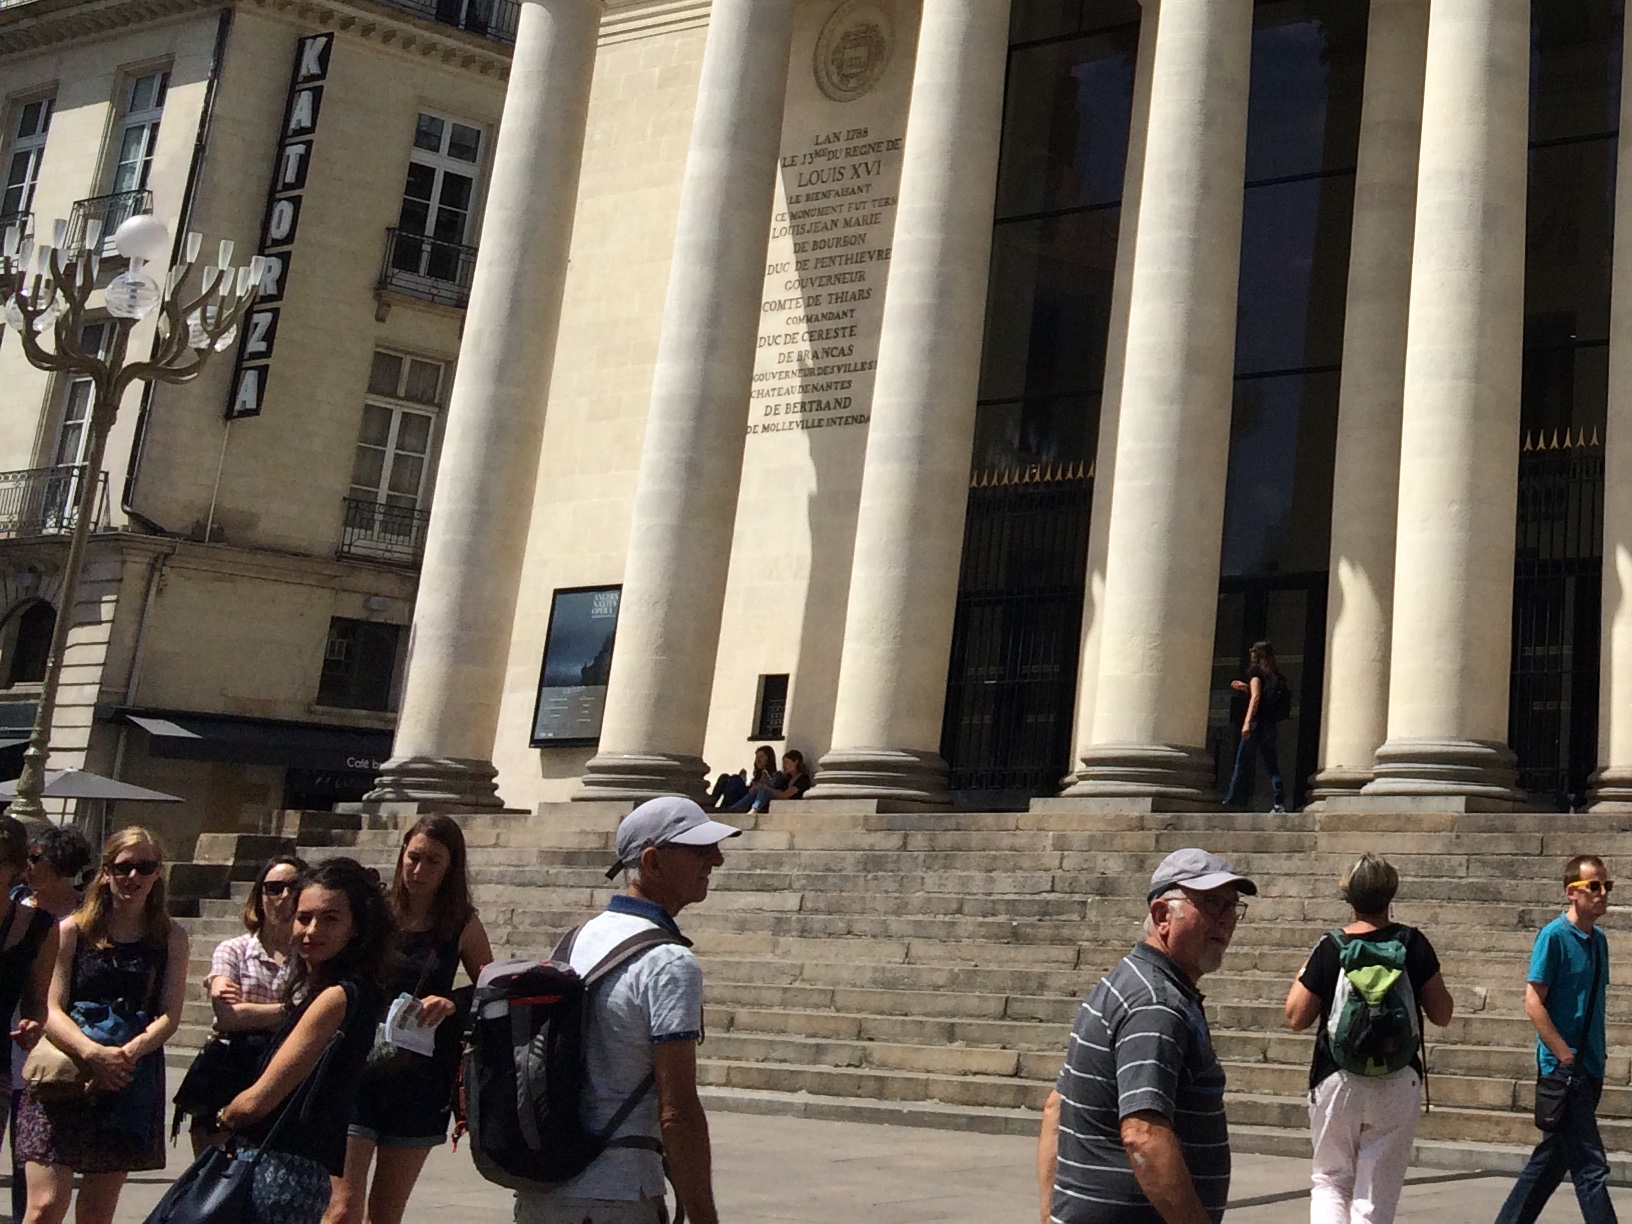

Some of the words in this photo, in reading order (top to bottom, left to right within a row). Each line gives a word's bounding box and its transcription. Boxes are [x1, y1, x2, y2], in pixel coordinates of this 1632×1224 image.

[781, 155, 799, 168] LE
[827, 148, 843, 162] DU
[844, 141, 885, 158] REGNE
[886, 138, 902, 152] DE
[797, 166, 846, 188] LOUIS
[849, 159, 882, 180] XVI
[788, 194, 802, 205] LE
[775, 212, 788, 222] CE
[790, 204, 844, 221] MONUMENT
[847, 200, 868, 212] FUT
[233, 36, 328, 412] KATORZA
[771, 223, 806, 239] LOUIS
[807, 218, 840, 234] JEAN
[842, 212, 882, 229] MARIE
[793, 241, 810, 254] DE
[812, 233, 867, 251] BOURBON
[767, 262, 790, 275] DUC
[794, 259, 810, 272] DE
[785, 270, 866, 291] GOUVERNEUR
[762, 297, 803, 313] COMTE
[806, 294, 822, 308] DE
[827, 288, 873, 305] THIARS
[786, 308, 856, 326] COMMANDANT
[758, 335, 782, 348] DUC
[783, 332, 799, 345] DE
[801, 325, 858, 342] CERESTE
[777, 351, 794, 364] DE
[796, 344, 854, 362] BRANCAS
[763, 404, 781, 417] DE
[784, 396, 852, 415] BERTRAND
